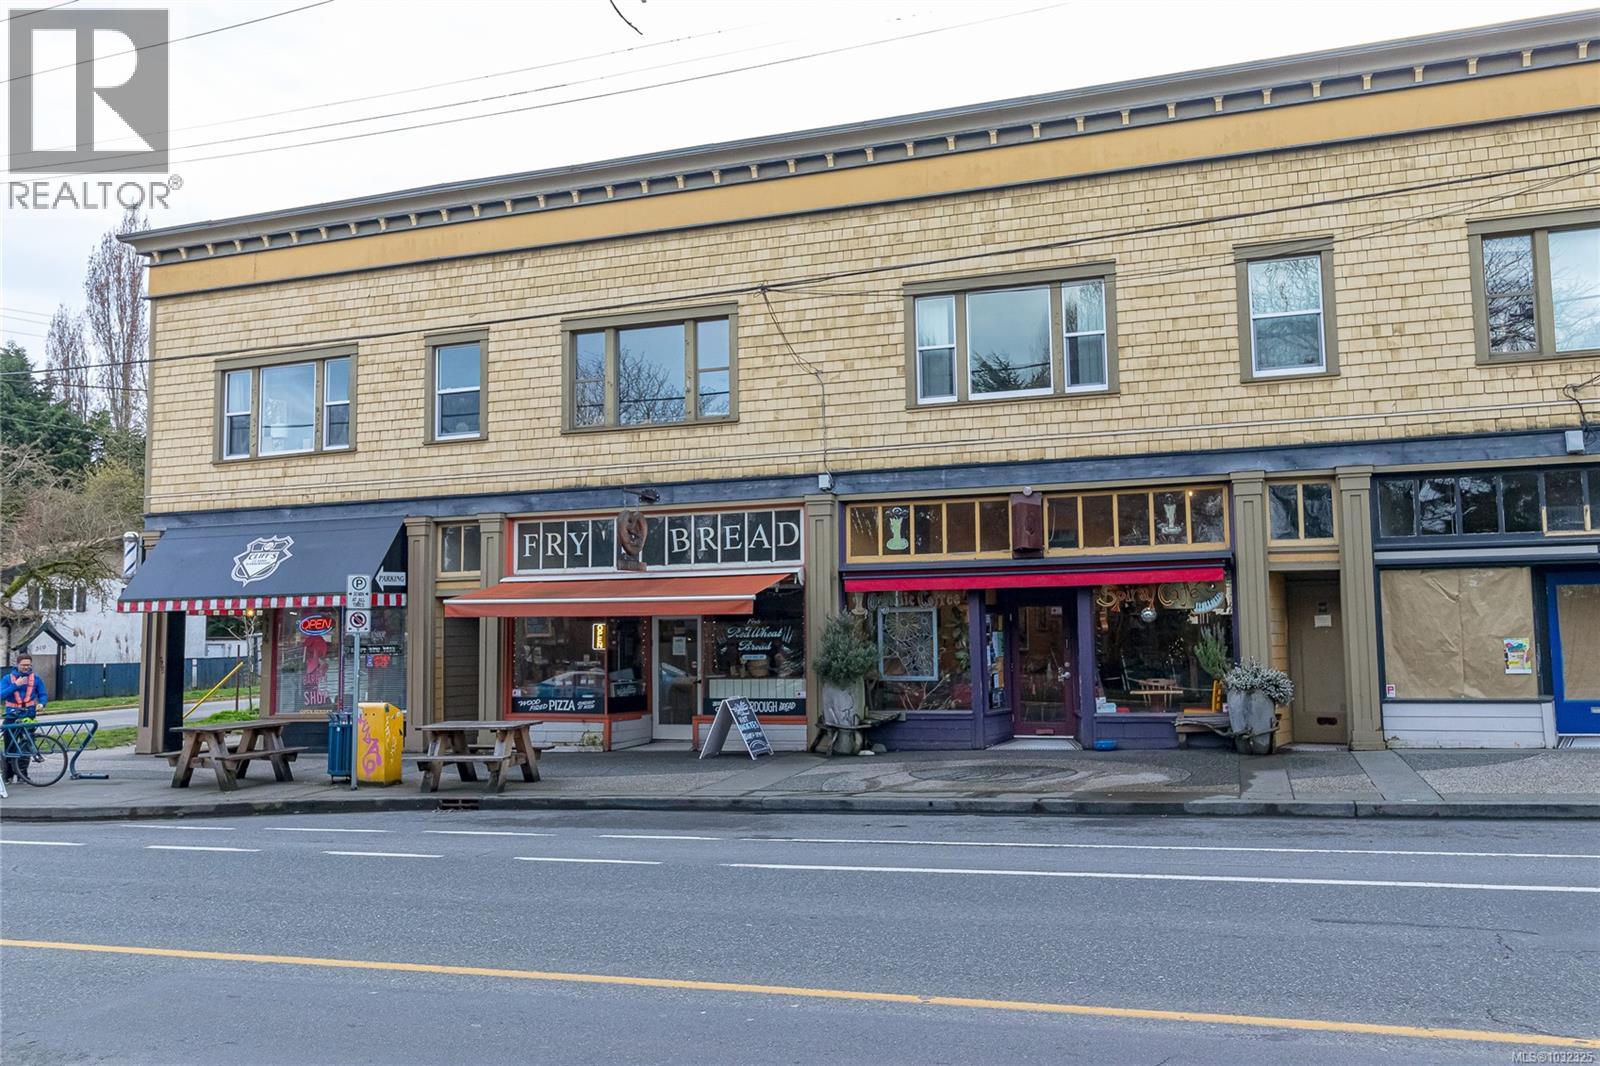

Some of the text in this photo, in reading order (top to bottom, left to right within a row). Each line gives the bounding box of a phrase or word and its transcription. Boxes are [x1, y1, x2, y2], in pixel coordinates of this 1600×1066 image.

[670, 521, 800, 553] BREAD
[356, 580, 363, 588] P
[379, 575, 405, 583] PARKING
[300, 618, 332, 629] OPEN
[303, 691, 328, 706] SHOP
[548, 700, 576, 711] PIZZA
